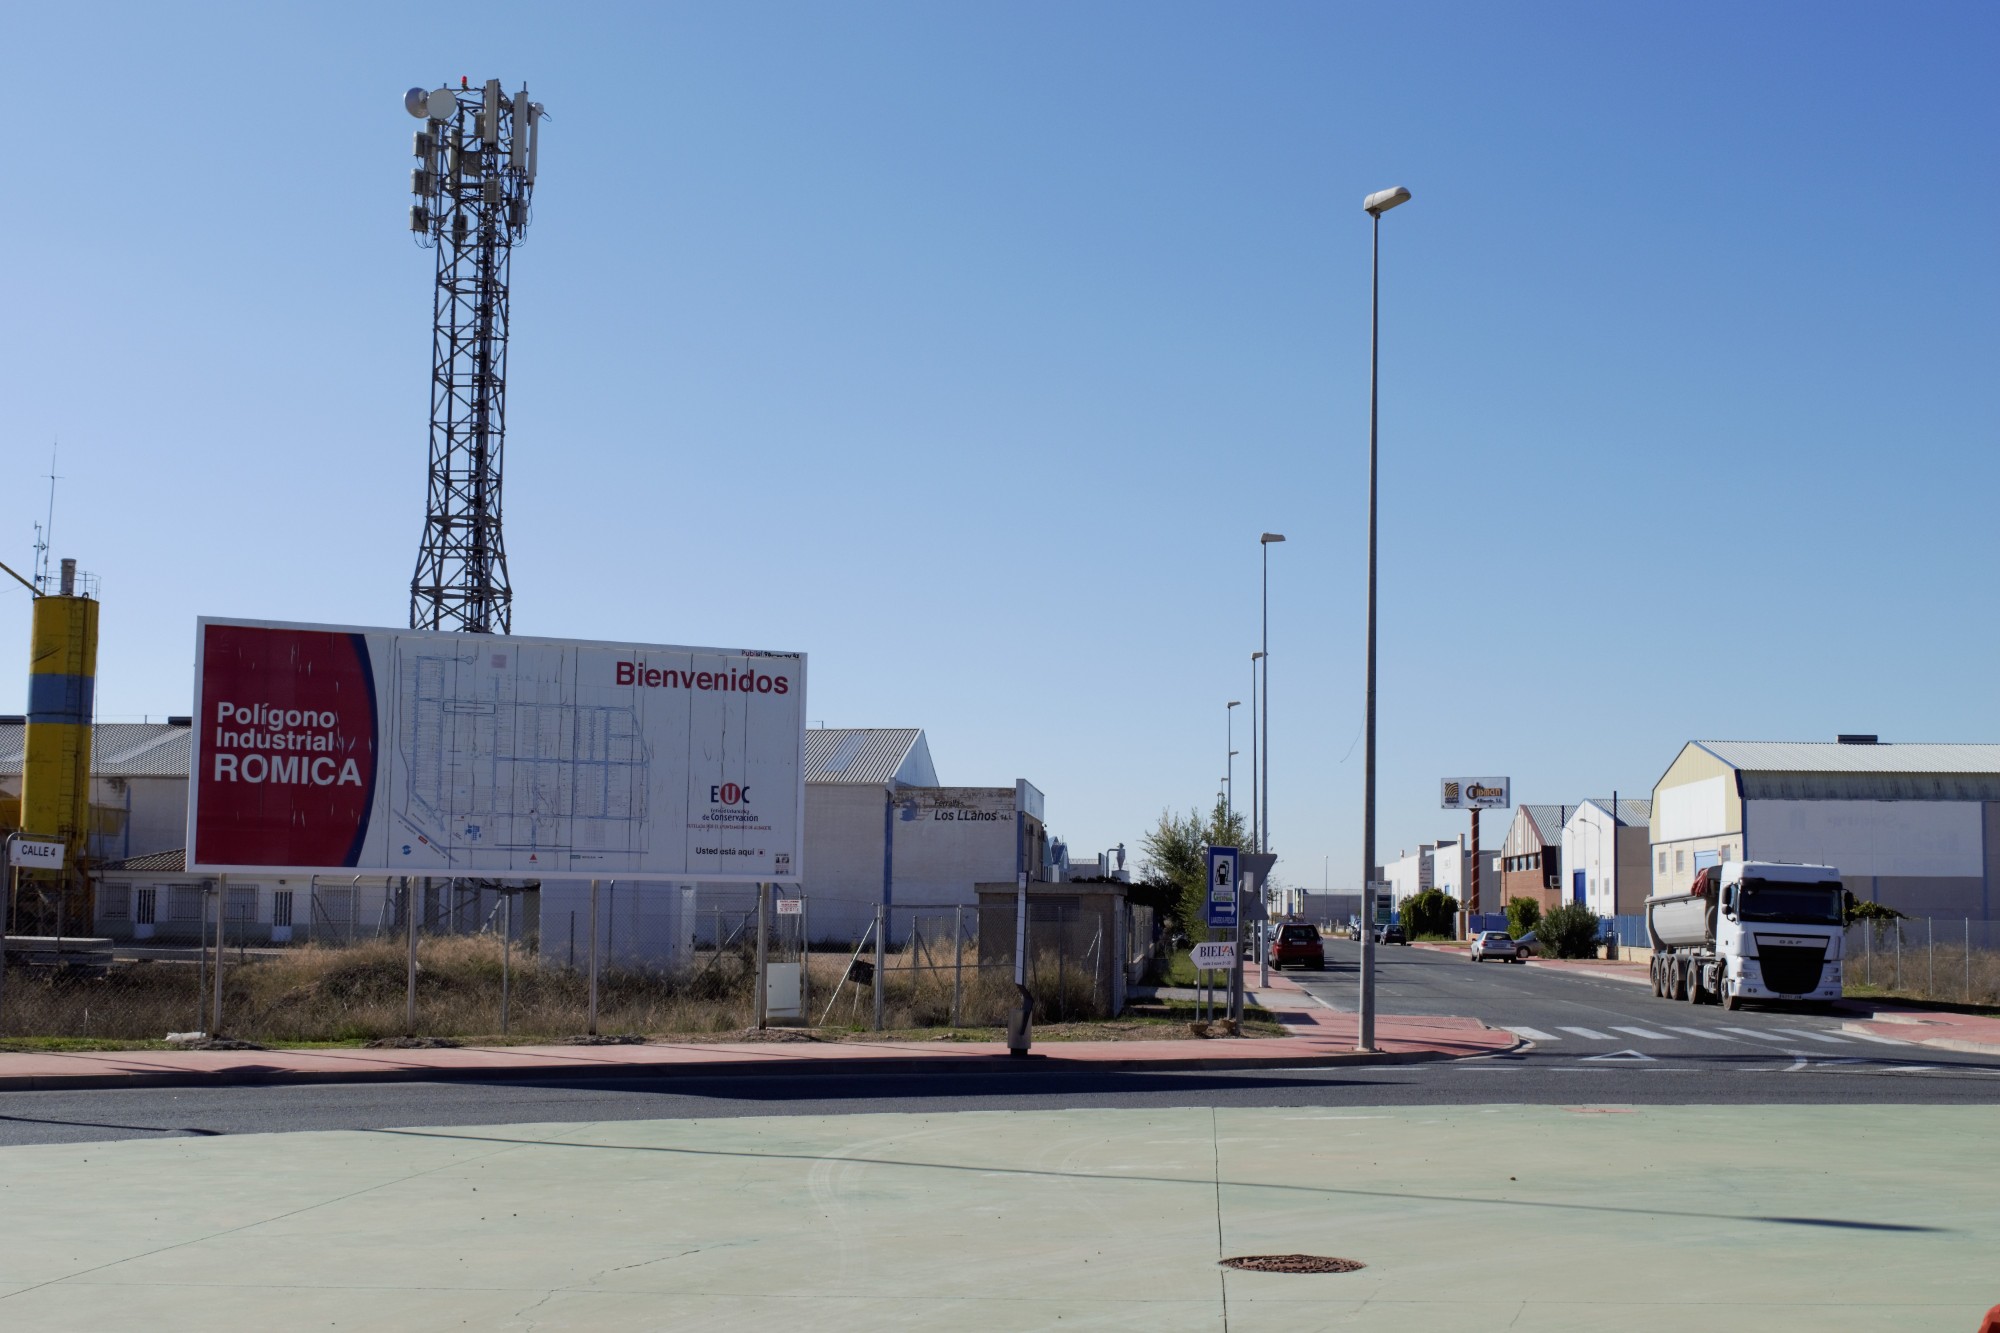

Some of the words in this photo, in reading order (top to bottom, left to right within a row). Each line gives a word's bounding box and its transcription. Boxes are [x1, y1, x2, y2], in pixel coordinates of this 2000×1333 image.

[616, 661, 789, 695] Bienvenidos
[217, 702, 335, 731] Polígono
[216, 727, 334, 752] Industrial
[214, 754, 362, 787] ROMICA
[710, 783, 750, 805] EUC
[710, 813, 758, 822] Conservación
[934, 810, 954, 821] Los
[957, 809, 997, 821] LLanos
[21, 844, 49, 857] CALLE
[50, 847, 56, 857] 4
[695, 846, 718, 855] Usted
[738, 848, 755, 857] aquí
[1200, 945, 1234, 957] BIELSA
